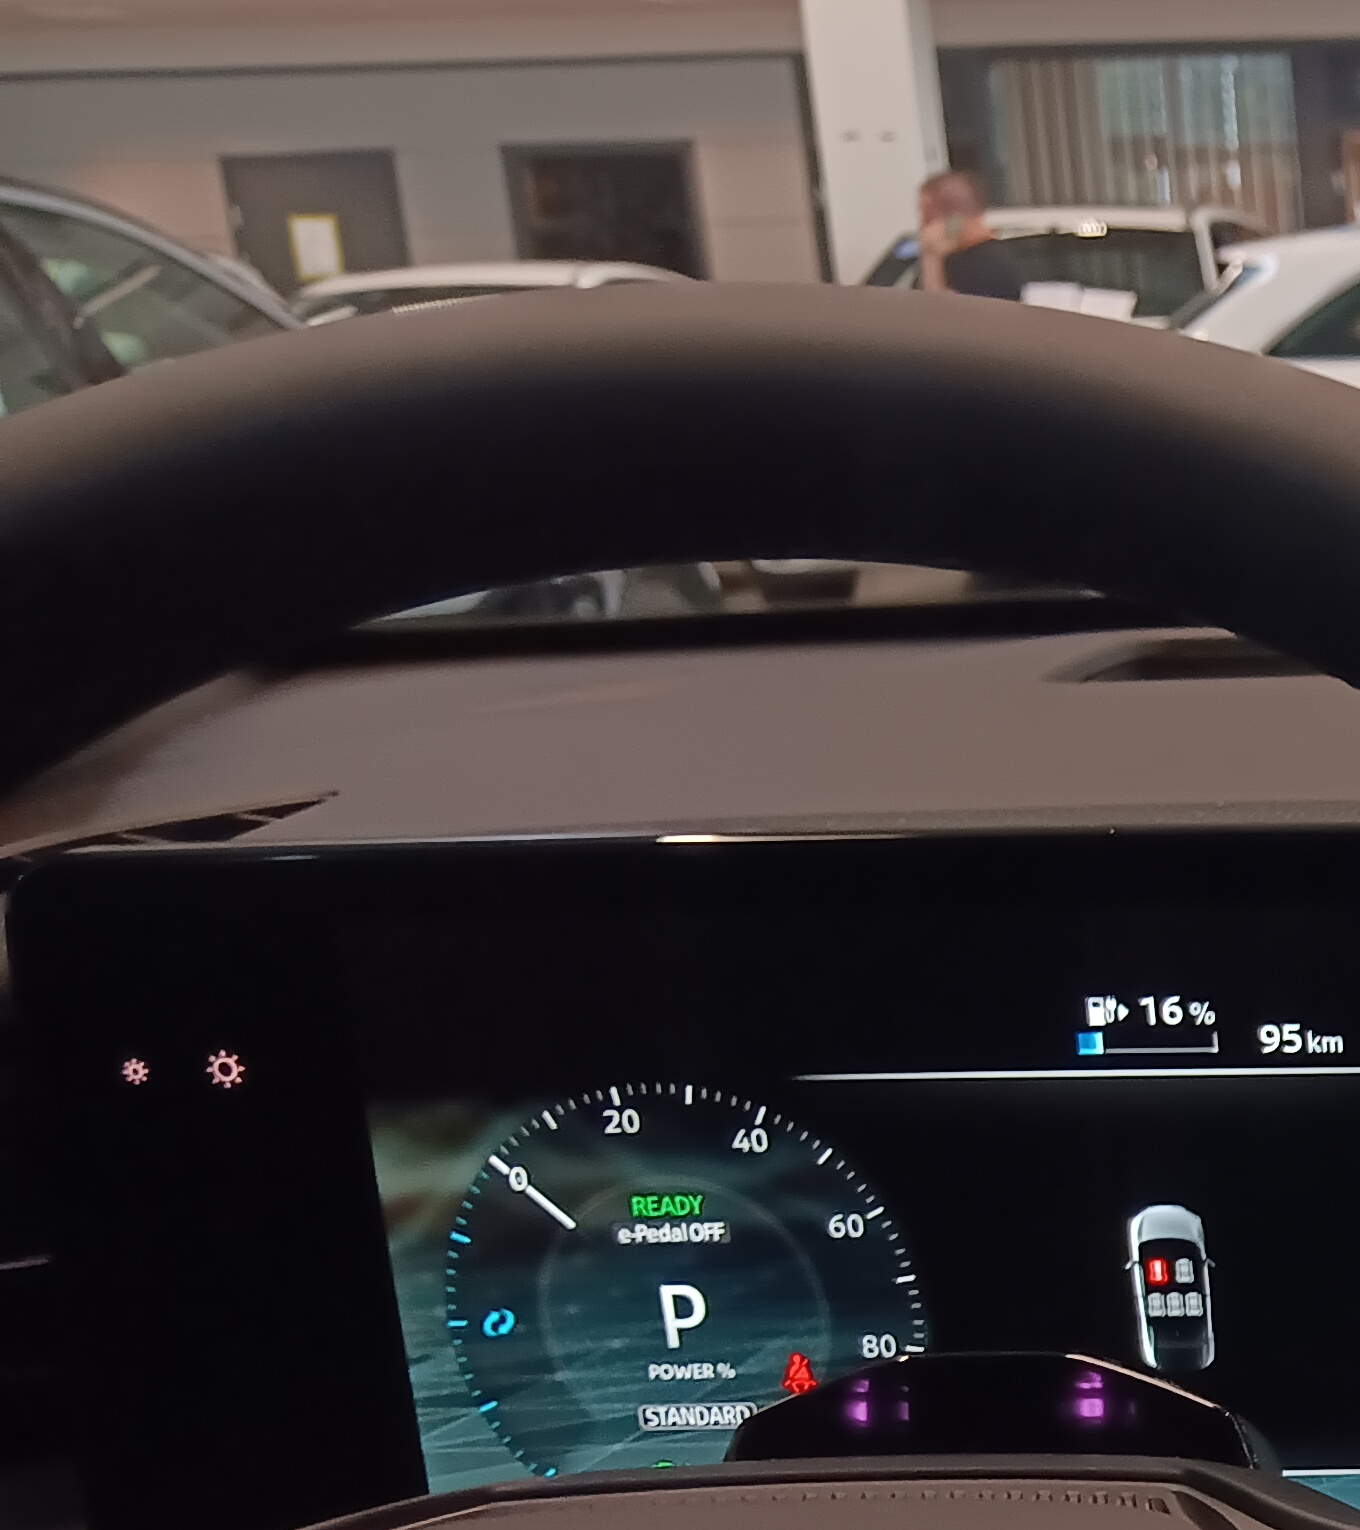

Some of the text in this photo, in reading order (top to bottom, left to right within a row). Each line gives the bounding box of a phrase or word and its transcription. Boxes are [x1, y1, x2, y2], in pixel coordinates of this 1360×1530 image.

[603, 1107, 640, 1134] 20
[732, 1128, 769, 1154] 40
[509, 1166, 528, 1191] 0
[631, 1195, 703, 1217] READY
[829, 1213, 865, 1239] 60
[659, 1284, 706, 1349] P
[861, 1332, 897, 1359] 80
[648, 1362, 714, 1380] POWER
[645, 1405, 751, 1427] STANDARD
